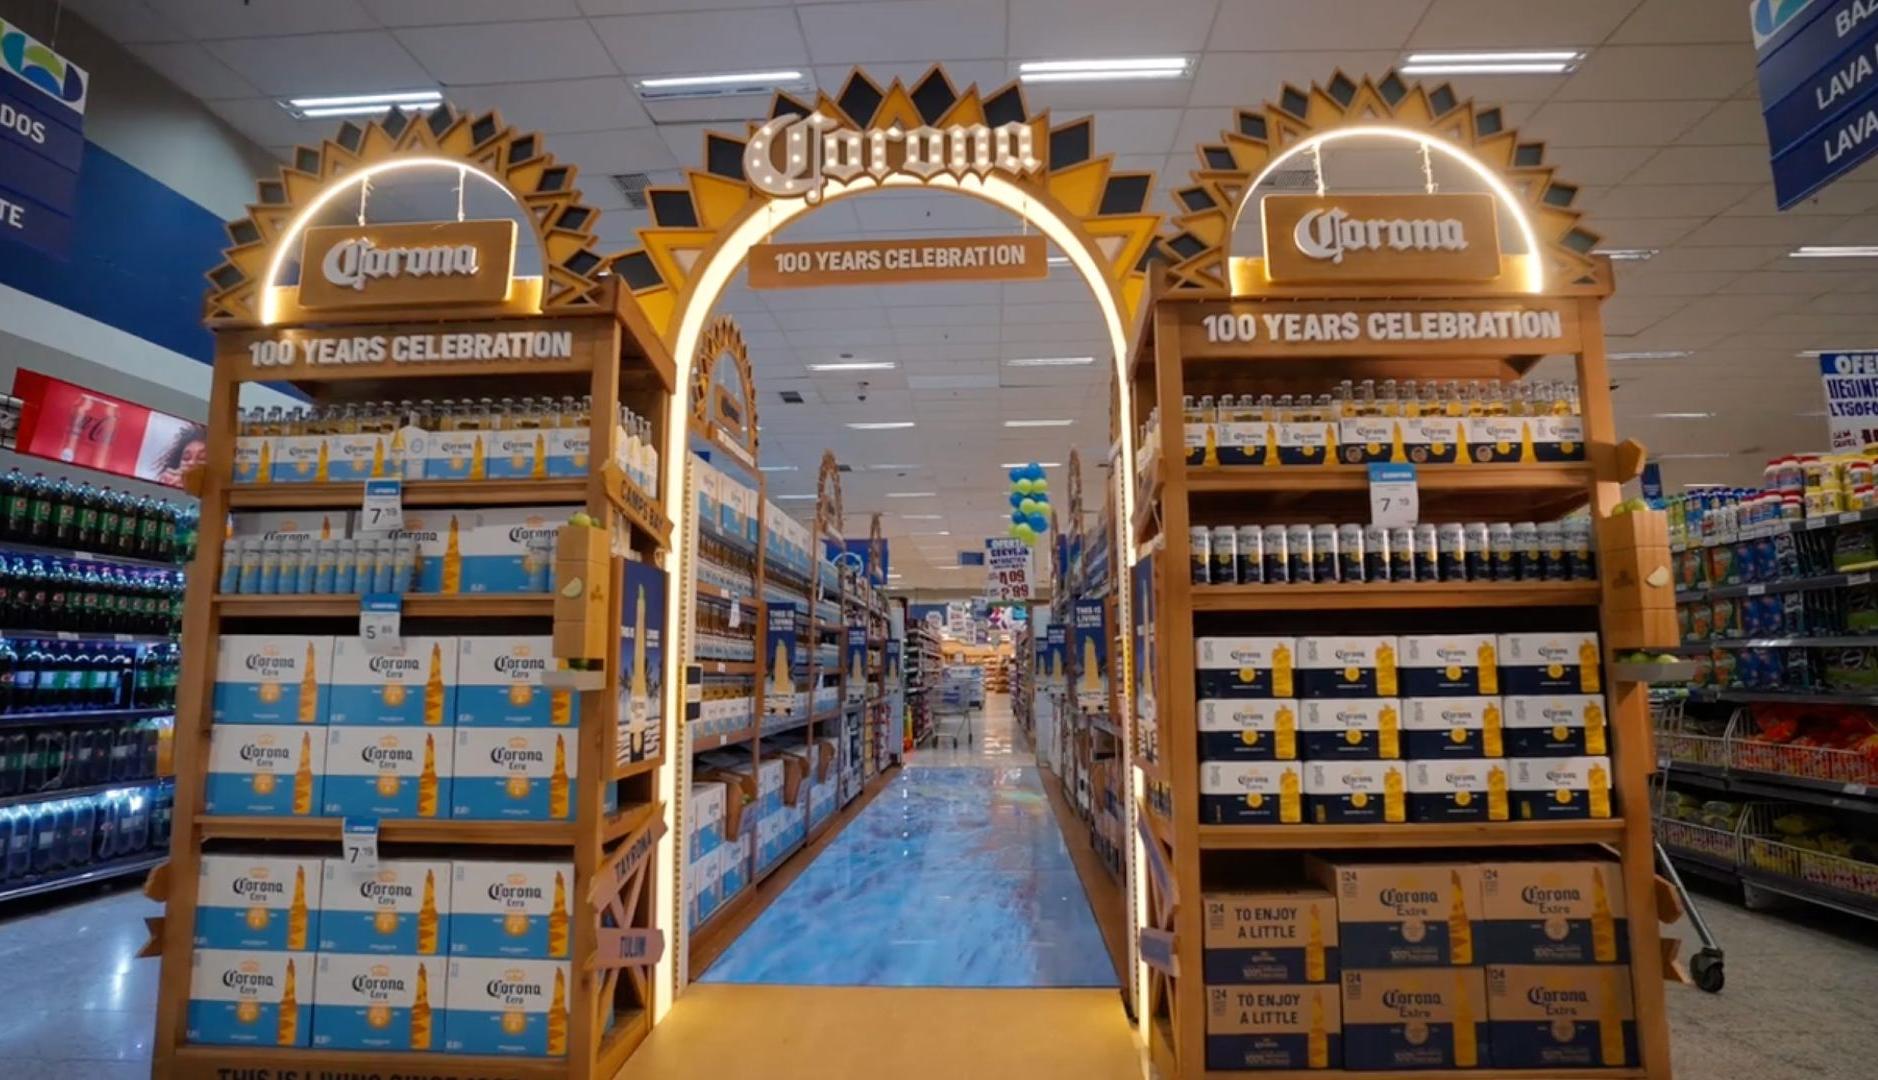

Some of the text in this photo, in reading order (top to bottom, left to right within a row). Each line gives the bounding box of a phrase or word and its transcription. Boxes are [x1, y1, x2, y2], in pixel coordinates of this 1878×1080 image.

[1816, 54, 1873, 110] LAVA
[0, 103, 45, 144] DOS
[1824, 110, 1878, 164] LAVA
[742, 110, 1043, 203] Corona
[1293, 206, 1470, 264] Corona
[322, 236, 480, 291] Corona
[774, 244, 1026, 273] 100 YEARS CELEBRATION
[1203, 309, 1562, 342] 100 YEARS CELEBRATION
[249, 330, 573, 367] 100 YEARS CELEBRATION
[1834, 354, 1878, 374] OFE
[1380, 498, 1390, 512] 7
[370, 508, 381, 524] 7
[366, 625, 376, 640] 5
[246, 654, 295, 671] Corona
[369, 656, 420, 673] Corona
[493, 655, 546, 672] Corona
[239, 744, 290, 761] Corona
[361, 745, 413, 763] Corona
[490, 747, 544, 764] Corona
[349, 847, 359, 864] 7
[232, 877, 284, 895] Corona
[360, 880, 413, 898] Corona
[487, 883, 543, 900] Corona
[1521, 885, 1580, 904] Corona
[1379, 888, 1438, 906] Corona
[1235, 907, 1298, 921] TO ENJOY
[1396, 905, 1428, 916] Extra
[1538, 903, 1571, 914] Extra
[1238, 925, 1296, 939] A LITTLE
[222, 969, 274, 987] Corona
[352, 974, 405, 993] Corona
[486, 979, 542, 997] Corona
[1527, 985, 1587, 1005] Corona
[1237, 993, 1301, 1007] TO ENJOY
[1382, 988, 1442, 1008] Corona
[1240, 1012, 1298, 1025] A LITTLE
[1399, 1007, 1431, 1018] Extra
[1545, 1004, 1577, 1016] Extra
